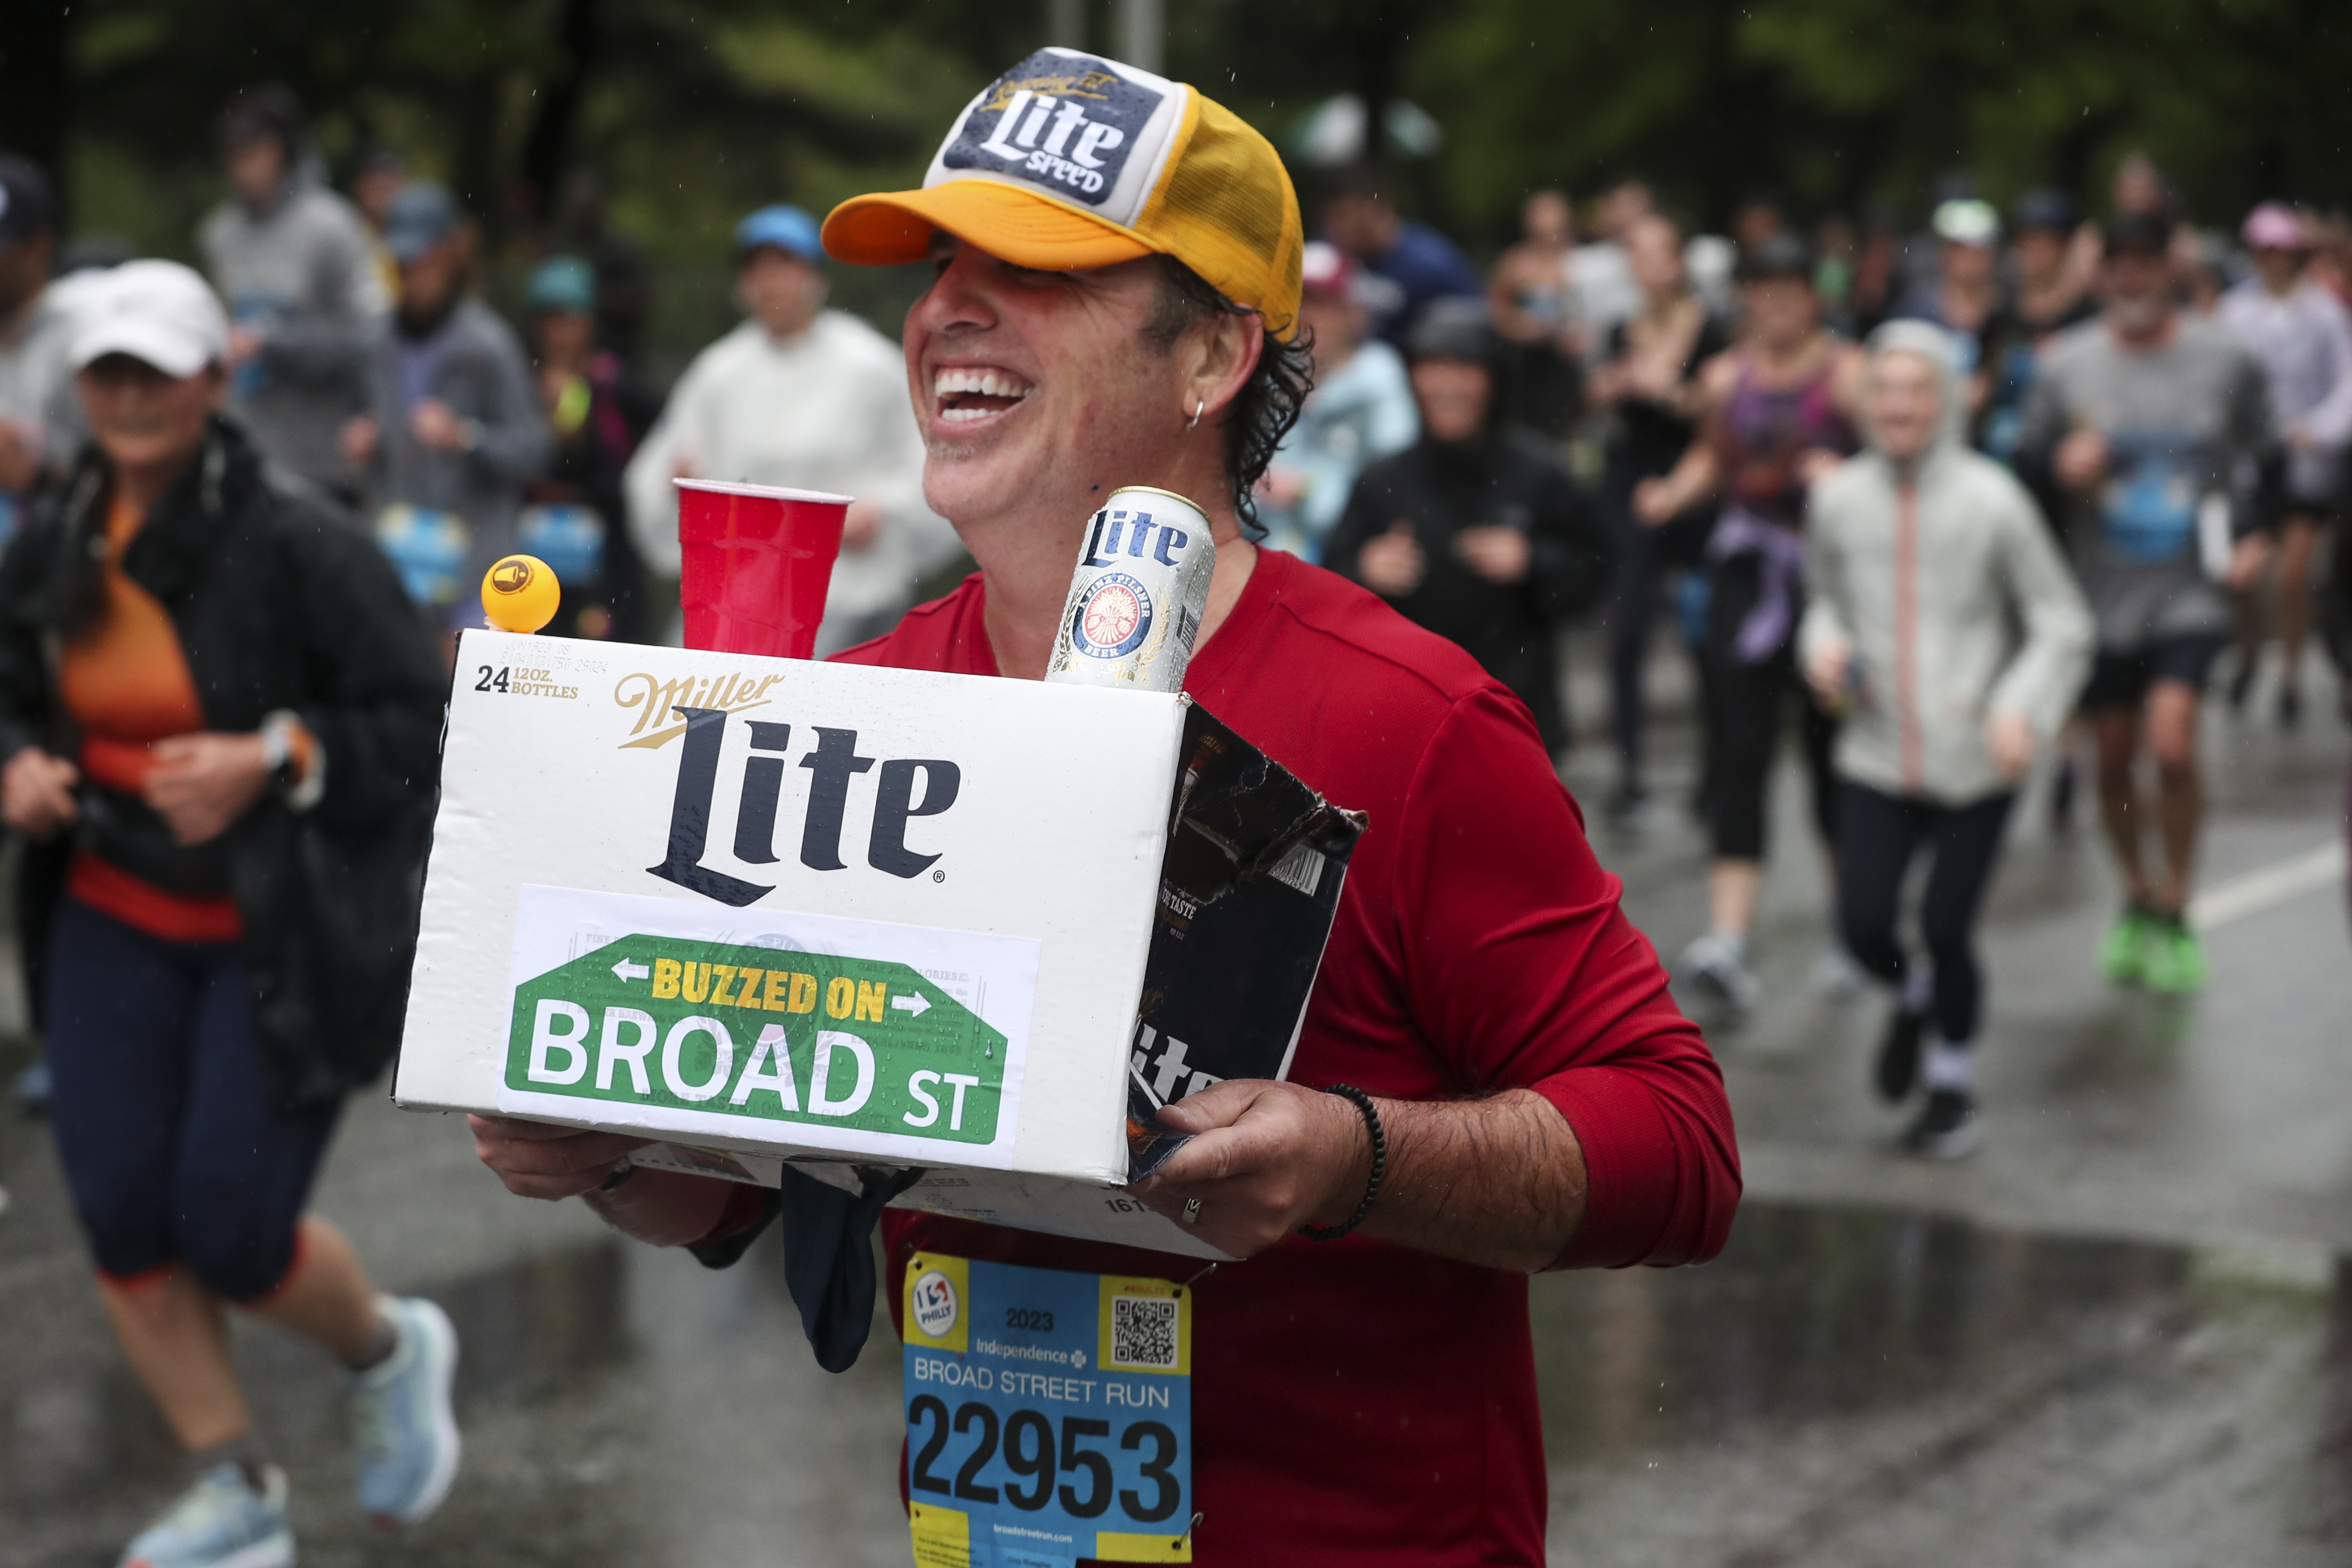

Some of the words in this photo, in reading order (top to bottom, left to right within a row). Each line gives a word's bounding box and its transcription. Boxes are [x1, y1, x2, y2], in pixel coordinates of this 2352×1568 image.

[980, 89, 1124, 169] Lite
[1081, 510, 1188, 568] Lite
[1116, 575, 1150, 618] PILSNER
[1084, 645, 1119, 657] BEER
[475, 665, 510, 693] 24
[513, 667, 553, 682] 12OZ.
[511, 682, 579, 699] BOTTLES
[614, 672, 786, 749] Miller
[645, 705, 961, 907] Lite
[1170, 894, 1197, 920] TASTE
[652, 957, 818, 1014] BUZZED
[826, 977, 887, 1023] ON
[528, 998, 876, 1117] BROAD
[903, 1069, 979, 1132] ST
[1105, 1198, 1153, 1213] 161
[921, 1305, 951, 1324] PHILLY
[1006, 1308, 1055, 1332] 2023
[977, 1338, 1068, 1365] Independence
[915, 1357, 993, 1390] BROAD
[1000, 1370, 1097, 1404] STREET
[1106, 1384, 1169, 1408] RUN
[909, 1394, 1181, 1523] 22953
[994, 1523, 1073, 1544] broadstreetrun.com
